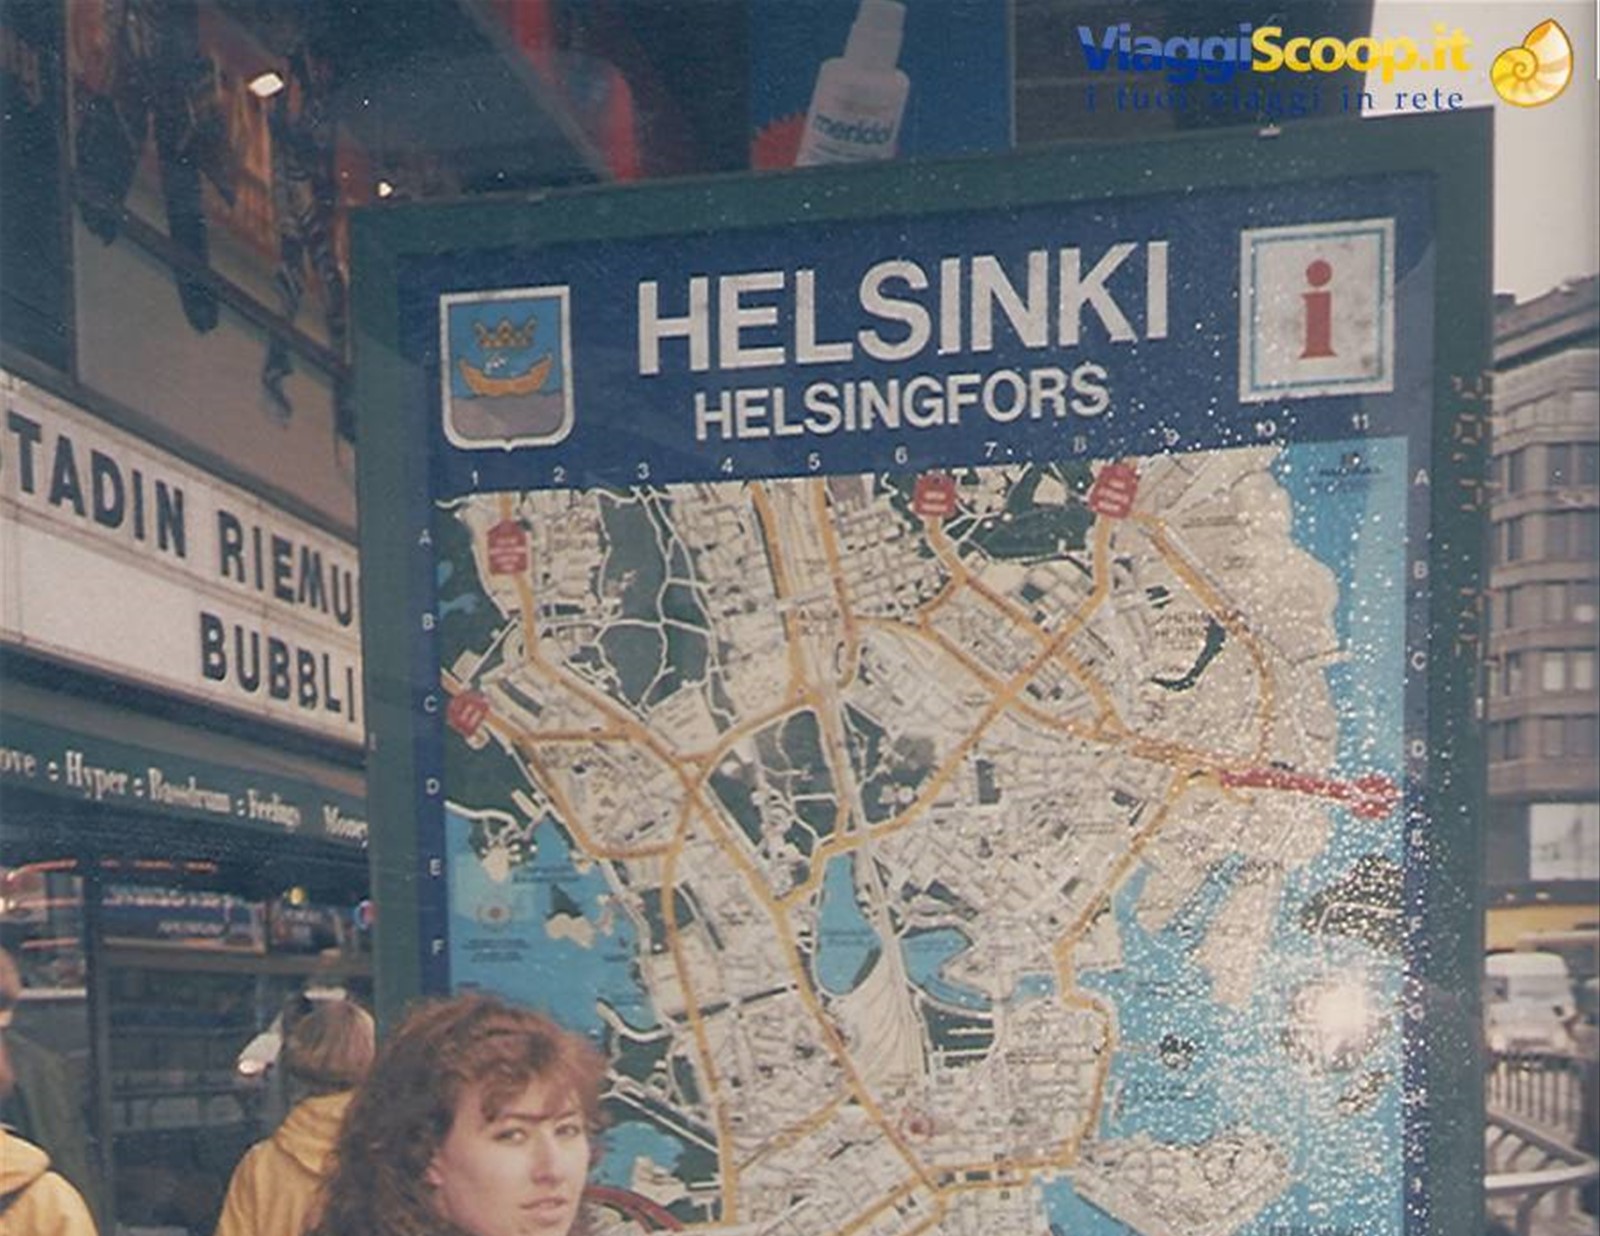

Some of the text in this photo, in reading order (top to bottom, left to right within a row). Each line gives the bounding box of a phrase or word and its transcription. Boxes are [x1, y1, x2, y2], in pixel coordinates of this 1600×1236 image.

[637, 240, 1169, 375] HELSINKI
[694, 360, 1110, 440] HELSINGFORS
[471, 471, 479, 485] 1
[554, 467, 566, 483] 2
[638, 464, 650, 480] 3
[721, 458, 734, 474] 4
[808, 453, 821, 471] 5
[895, 447, 908, 465] 6
[984, 442, 998, 458] 7
[1351, 413, 1369, 430] 11
[1413, 468, 1431, 486] A
[0, 410, 354, 628] TADIN RIEMU
[419, 528, 432, 546] A
[1412, 560, 1428, 579] B
[422, 613, 435, 630] B
[199, 611, 356, 724] BUBBLI
[1410, 651, 1427, 671] C
[424, 695, 438, 713] C
[1410, 739, 1426, 758] D
[65, 750, 129, 801] Hyper
[425, 778, 440, 794] D
[429, 859, 441, 875] E
[432, 940, 443, 955] F
